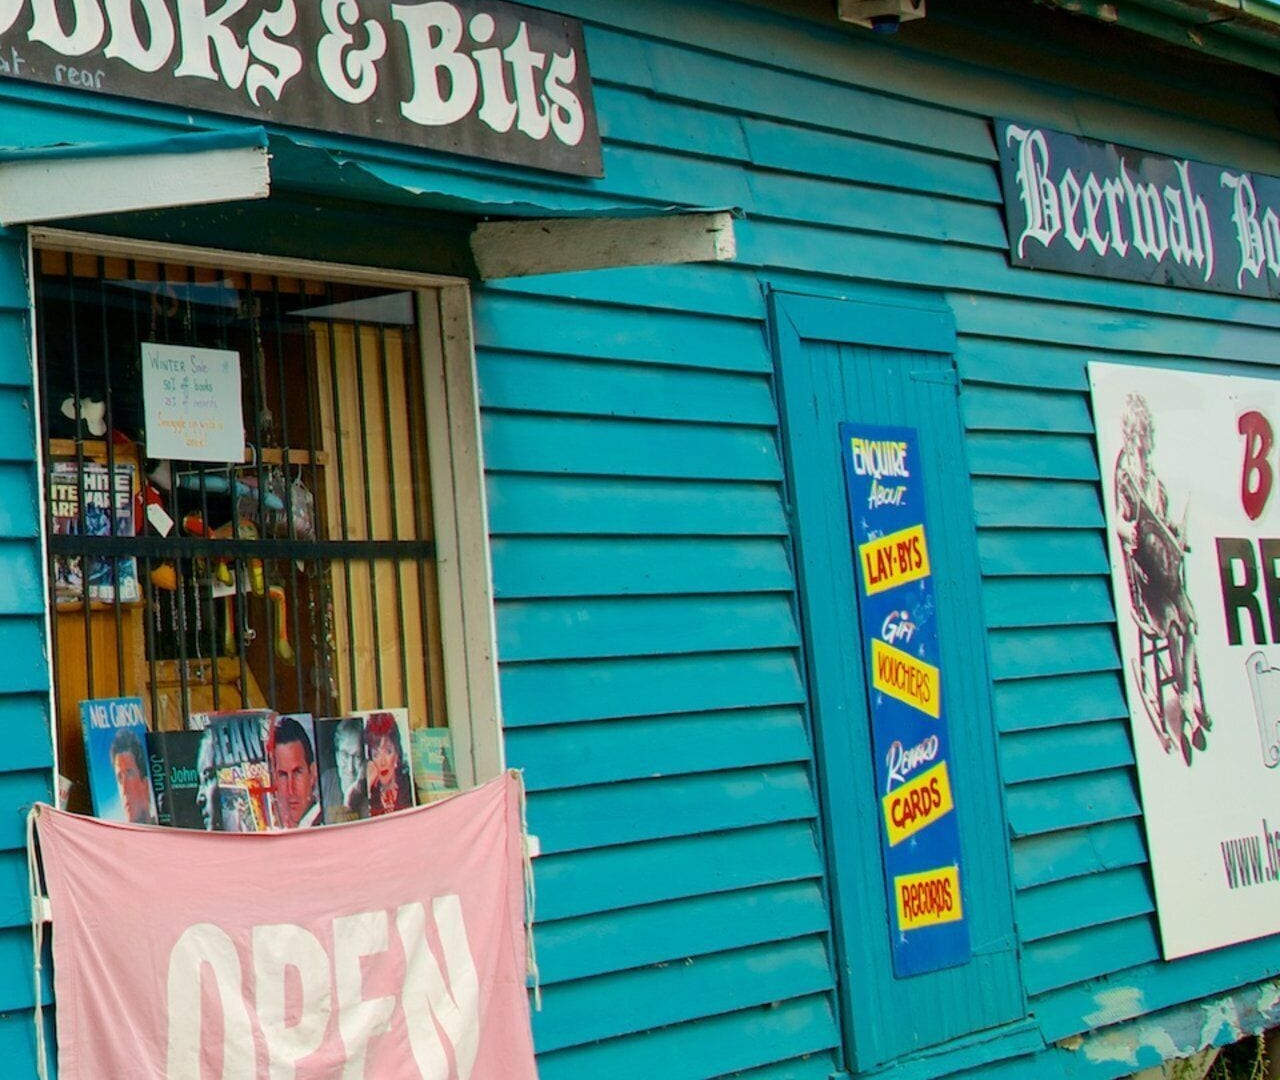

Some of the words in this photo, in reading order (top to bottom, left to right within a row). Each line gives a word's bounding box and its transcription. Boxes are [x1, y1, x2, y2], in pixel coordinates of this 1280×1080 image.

[53, 61, 108, 91] rear
[391, 0, 586, 147] Bits
[1006, 124, 1216, 283] Beerwah
[851, 437, 910, 480] ENQUIRE
[865, 535, 925, 585] LAY-BYS
[877, 651, 931, 705] VOUCHERS
[89, 704, 111, 729] MEL
[110, 702, 145, 728] GIBSON
[150, 754, 167, 792] John
[170, 766, 199, 784] John
[891, 777, 942, 829] CARDS
[165, 894, 480, 1080] OPEN
